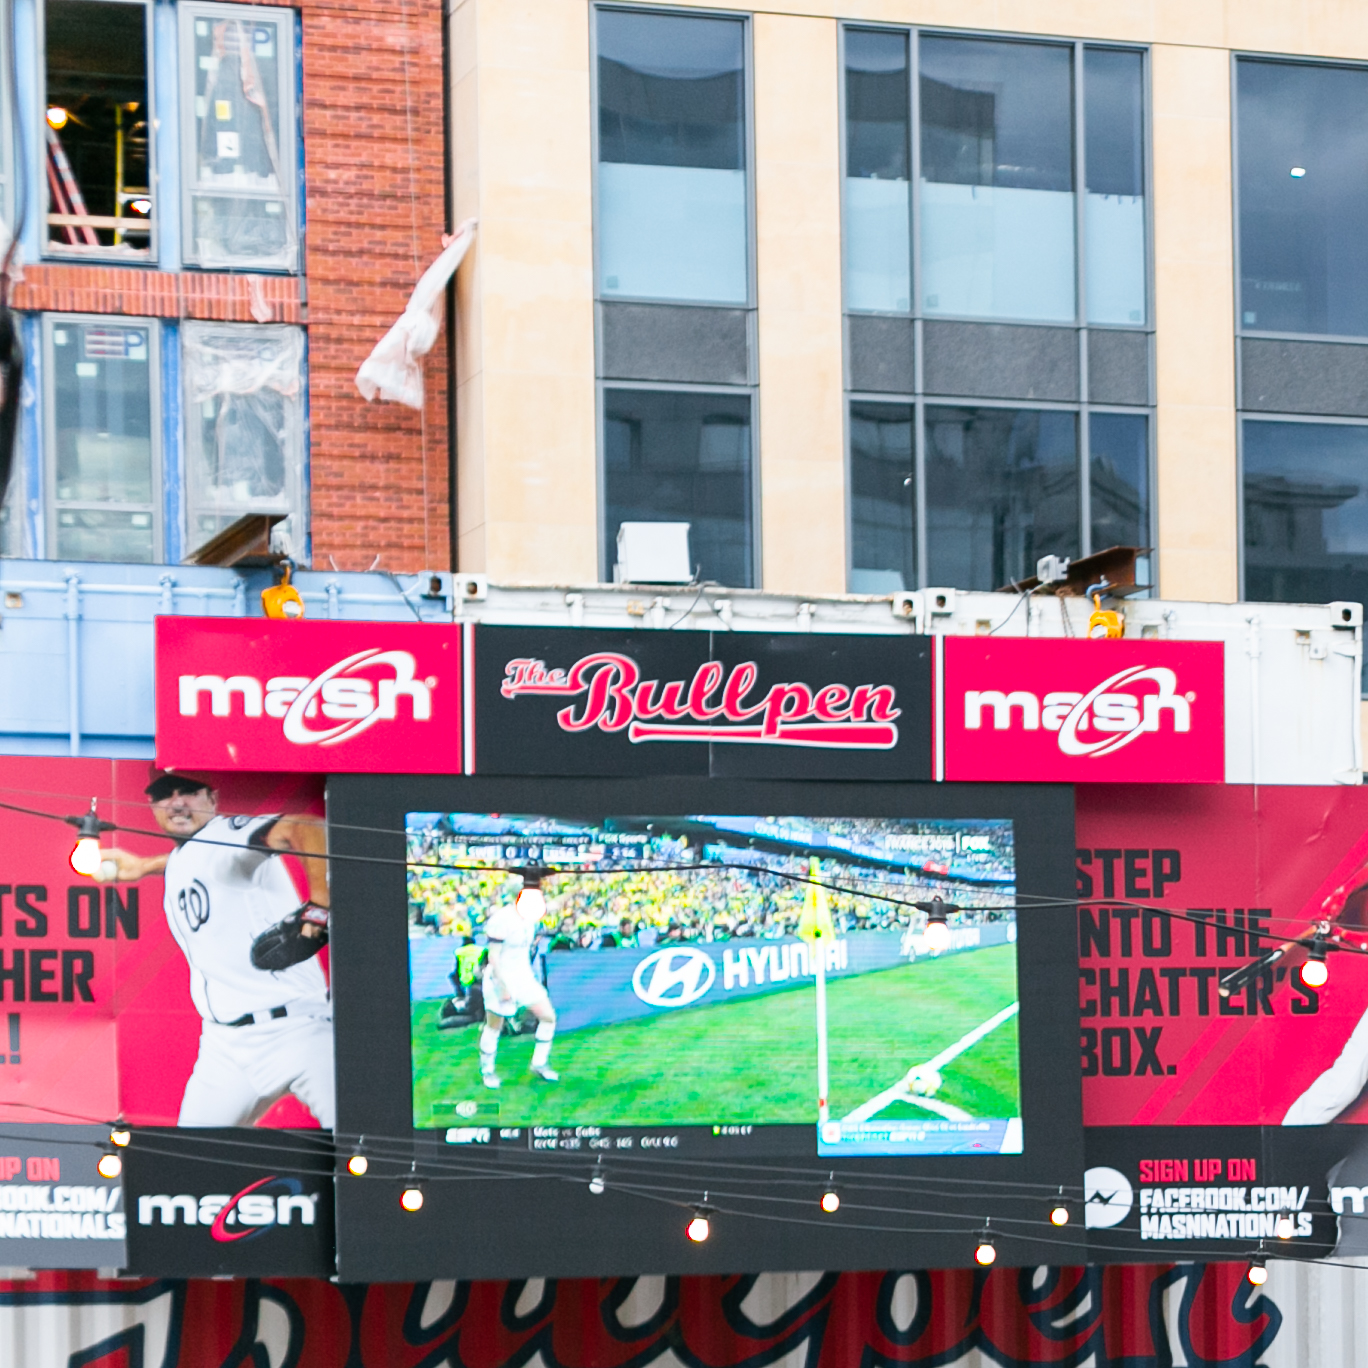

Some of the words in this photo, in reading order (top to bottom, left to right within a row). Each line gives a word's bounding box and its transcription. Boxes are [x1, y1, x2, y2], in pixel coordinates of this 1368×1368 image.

[502, 657, 567, 690] The
[557, 652, 901, 738] Bullpen
[67, 886, 139, 940] ON
[1186, 907, 1273, 958] THE
[26, 1158, 60, 1182] ON
[1139, 1159, 1189, 1183] SIGN
[1193, 1158, 1222, 1183] UP
[1227, 1158, 1257, 1182] ON
[138, 1184, 316, 1236] masn
[1140, 1186, 1310, 1214] FACEBOOK.COM/
